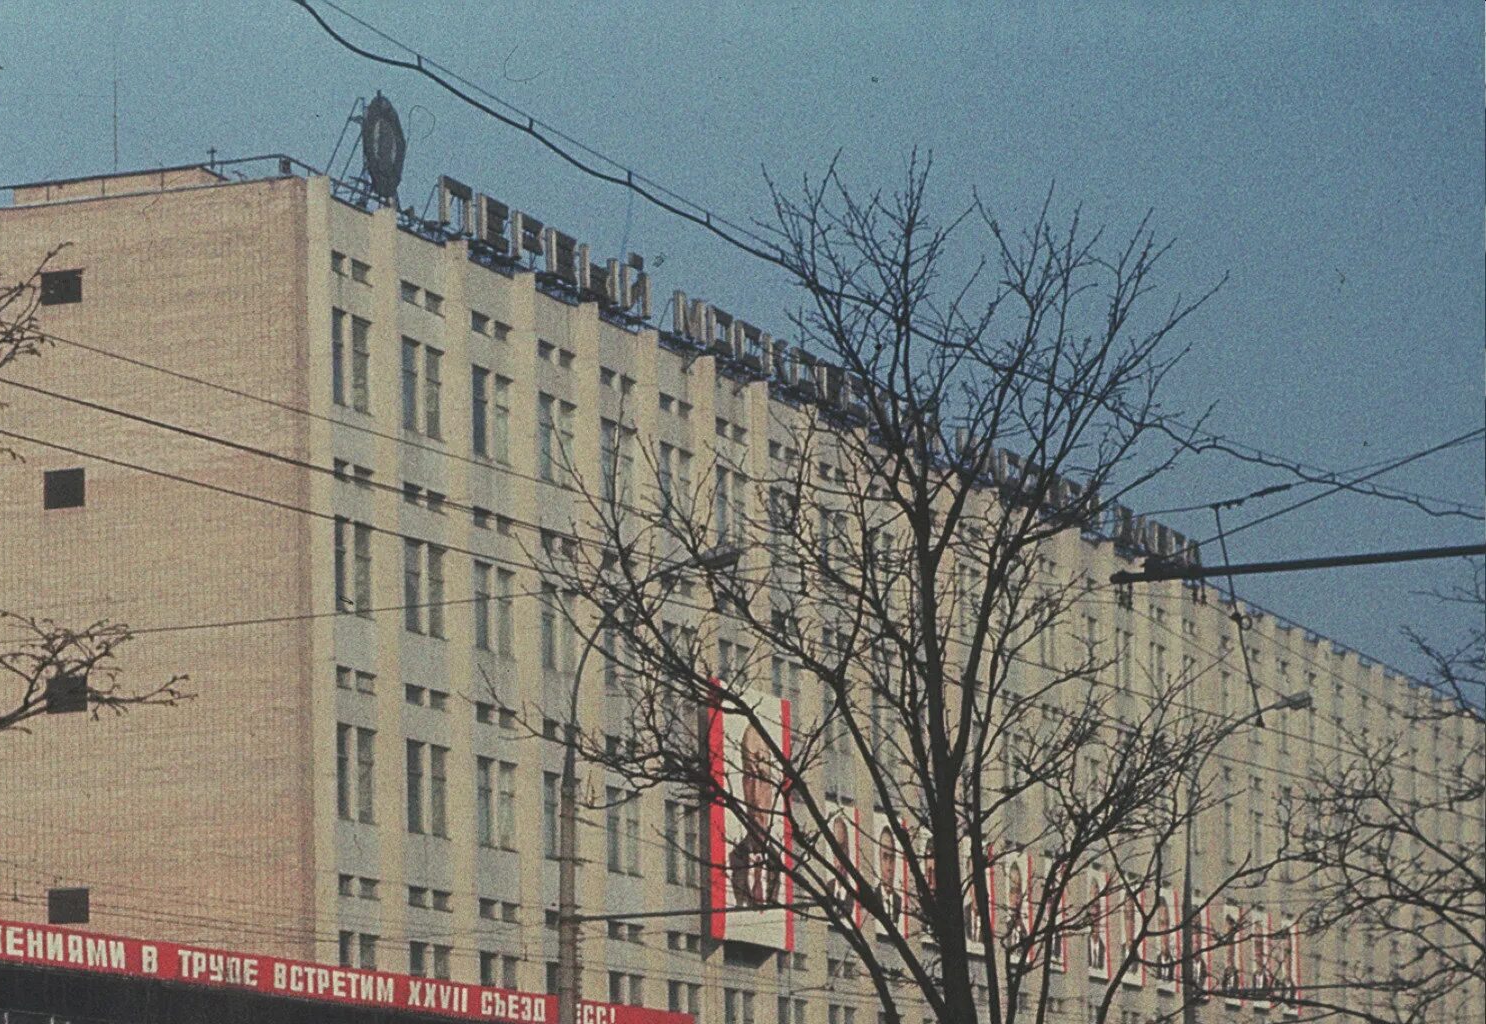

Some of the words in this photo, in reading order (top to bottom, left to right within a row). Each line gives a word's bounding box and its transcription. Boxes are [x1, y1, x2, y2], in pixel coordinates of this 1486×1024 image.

[141, 945, 159, 974] В
[177, 949, 258, 986] ТРУДЕ
[273, 962, 394, 1003] ВСТРЕТИМ
[407, 980, 468, 1013] XXVII
[481, 990, 546, 1022] СЪЕЗД
